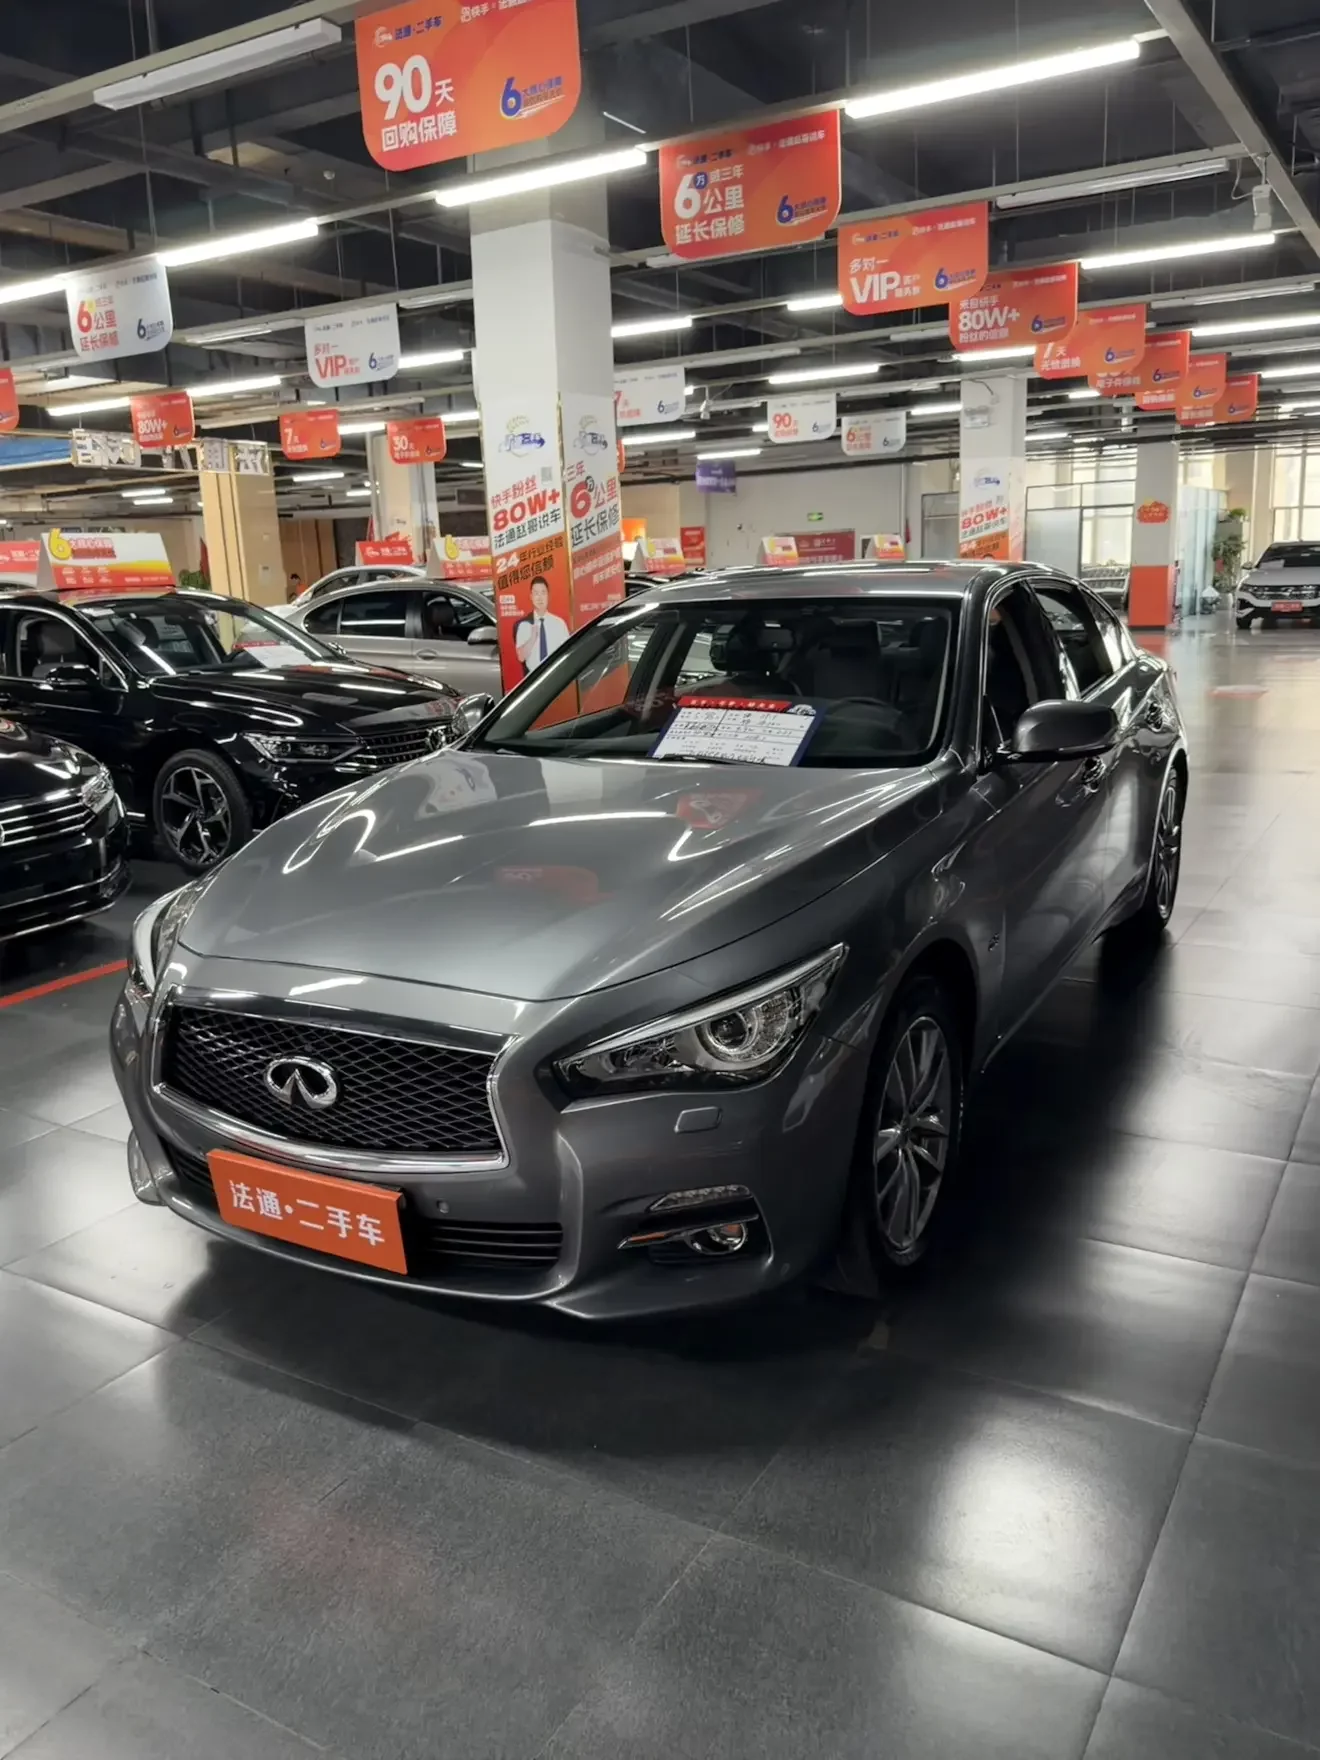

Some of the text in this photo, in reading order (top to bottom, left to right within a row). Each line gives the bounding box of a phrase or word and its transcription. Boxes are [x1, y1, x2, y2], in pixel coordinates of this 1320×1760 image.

[381, 111, 458, 152] 回购保障
[674, 212, 745, 246] 延长保修
[849, 256, 890, 275] 多对一
[849, 270, 901, 304] VIP
[959, 306, 1021, 334] 80W+
[315, 354, 347, 379] VIP
[566, 460, 586, 483] 三年
[490, 474, 538, 509] 快手粉丝
[493, 488, 561, 532] 80W+
[570, 503, 620, 549] 延长保修
[494, 507, 561, 549] 法通赵哥说车
[229, 1178, 386, 1247] 法通·二手车
